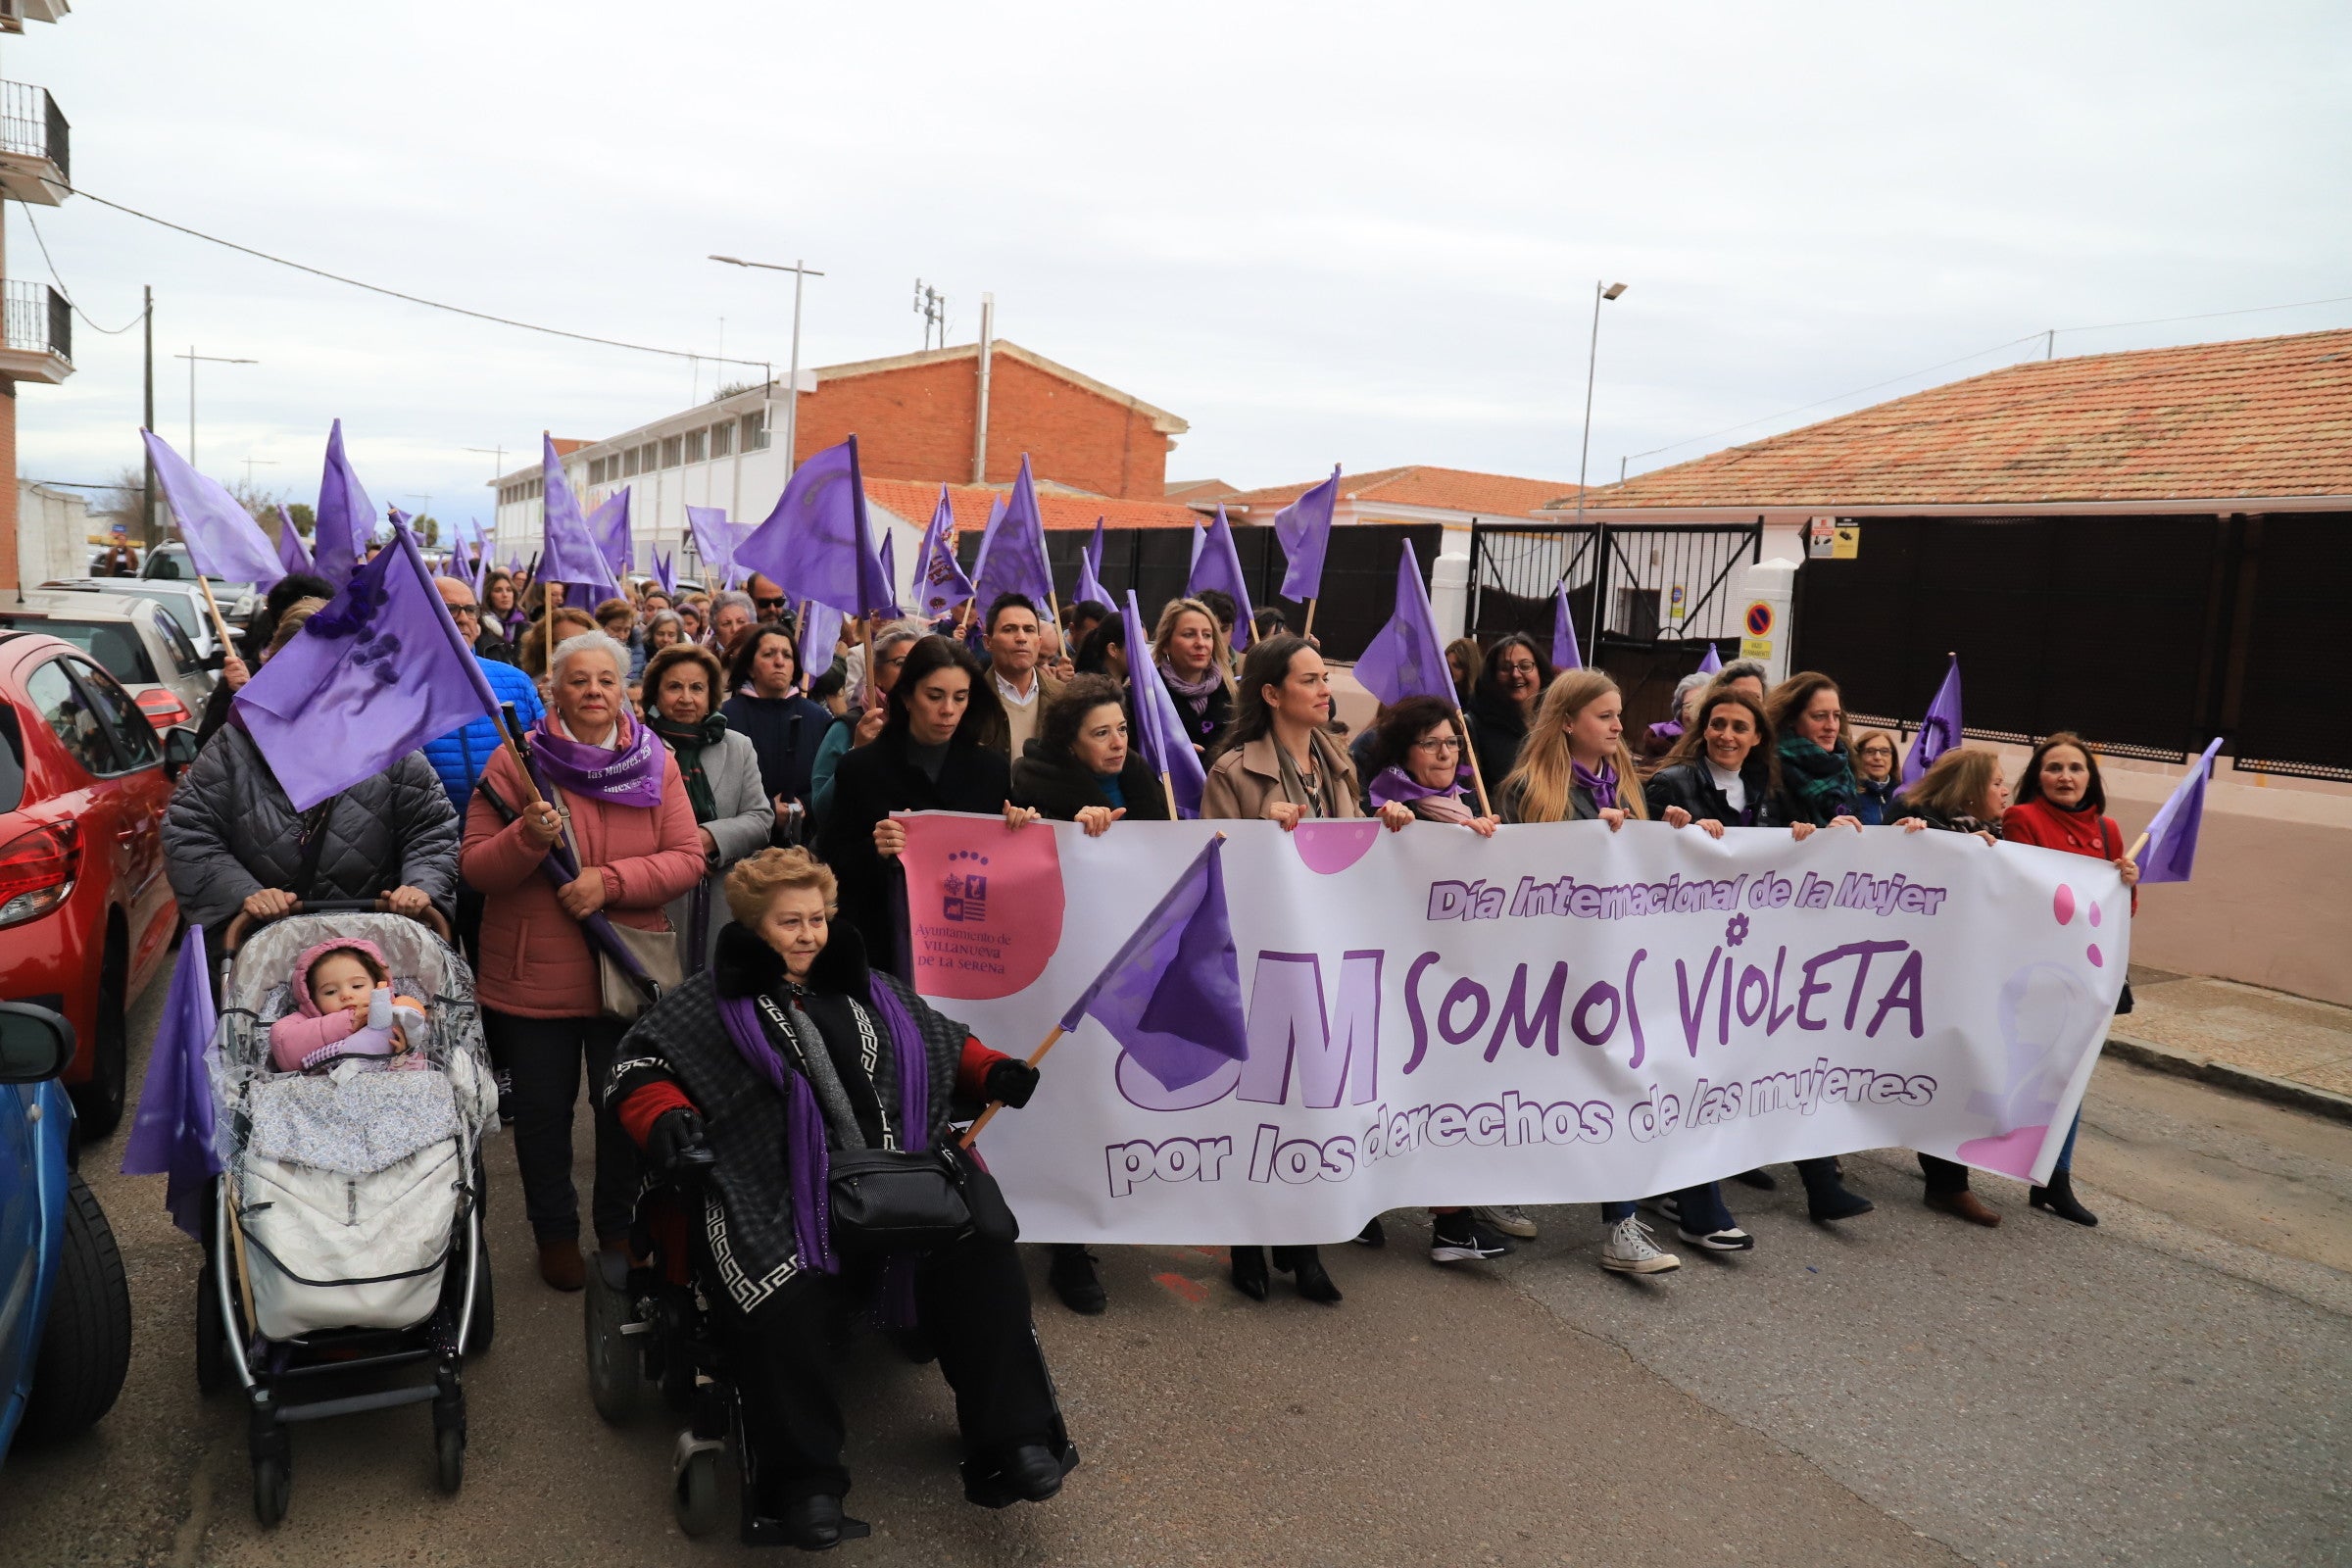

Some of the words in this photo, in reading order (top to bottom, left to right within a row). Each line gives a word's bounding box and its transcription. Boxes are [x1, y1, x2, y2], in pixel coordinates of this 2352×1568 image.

[587, 769, 603, 779] las
[1427, 878, 1506, 921] Día
[1510, 873, 1745, 920] Internacional
[1748, 870, 1793, 909] de
[1795, 871, 1833, 908] la
[1836, 872, 1947, 916] Mujer
[915, 924, 995, 943] Ayuntamiento
[997, 933, 1012, 946] de
[1115, 949, 1385, 1112] M
[1401, 948, 1647, 1075] SOMOS
[1106, 1135, 1232, 1198] por
[1249, 1123, 1356, 1185] los
[1362, 1090, 1614, 1168] derechos
[1629, 1083, 1679, 1144] de
[1685, 1078, 1742, 1129] las
[1749, 1056, 1938, 1117] mujeres
